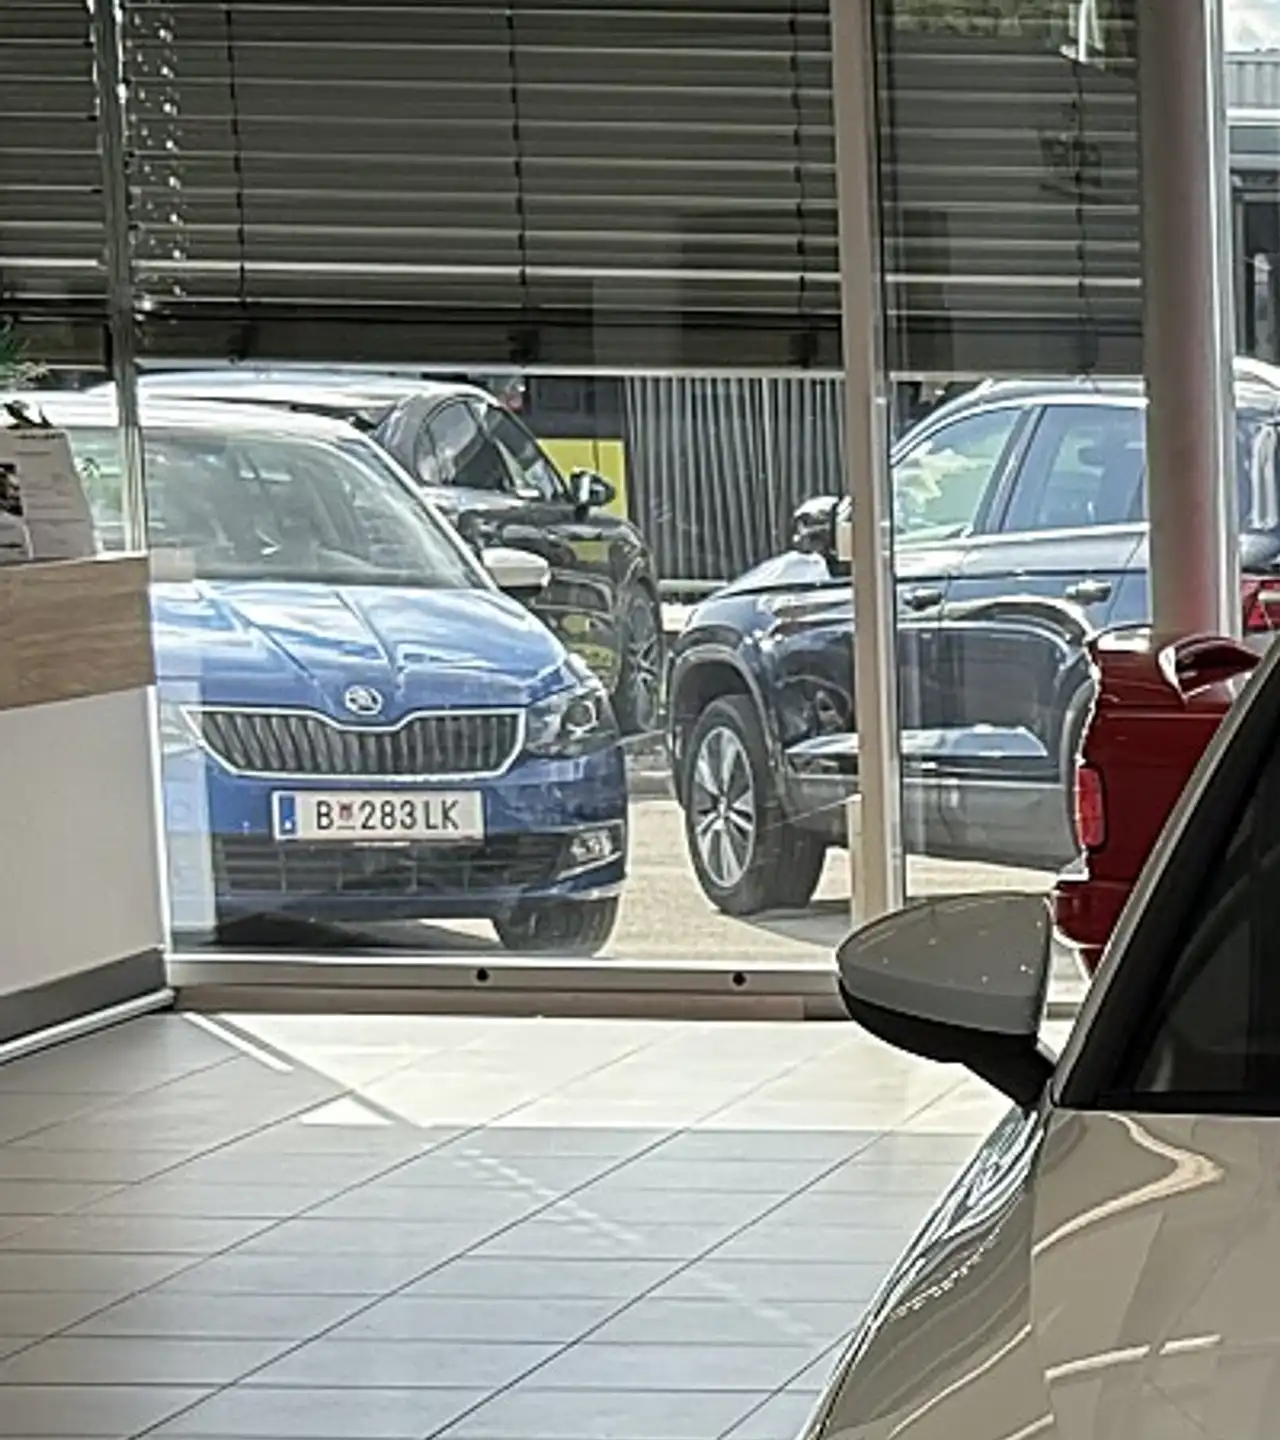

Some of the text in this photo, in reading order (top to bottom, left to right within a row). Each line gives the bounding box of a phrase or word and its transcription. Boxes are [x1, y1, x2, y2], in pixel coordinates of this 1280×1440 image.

[316, 799, 459, 830] B 283 LK
